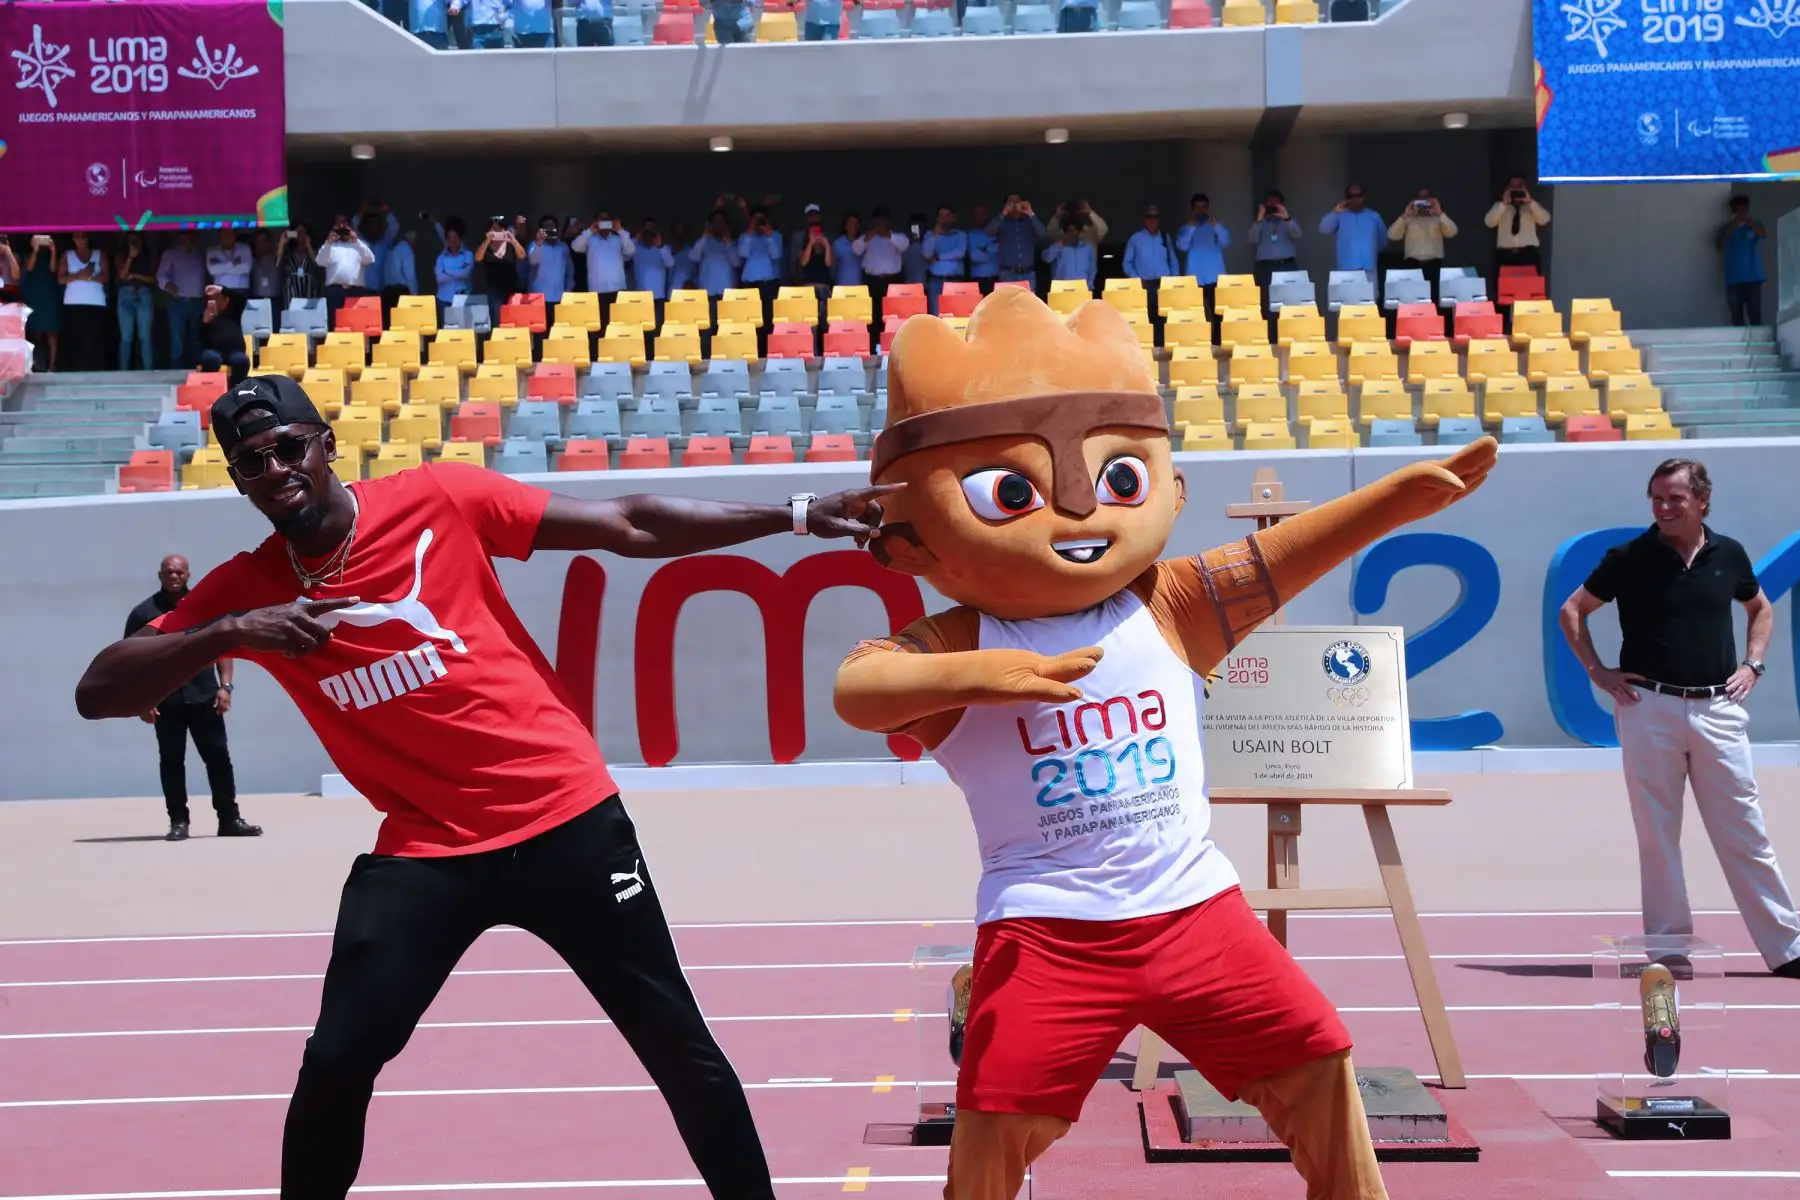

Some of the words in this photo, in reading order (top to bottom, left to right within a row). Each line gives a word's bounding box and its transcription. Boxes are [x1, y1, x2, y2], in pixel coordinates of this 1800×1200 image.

[1642, 13, 1725, 43] 2019
[90, 63, 169, 93] 2019
[1567, 63, 1604, 74] JUEGOS
[1607, 60, 1693, 72] PANAMERICANOS
[1695, 60, 1702, 70] Y
[19, 112, 54, 122] JUEGOS
[56, 111, 140, 122] PANAMERICANOS
[141, 111, 147, 120] Y
[149, 109, 256, 120] PARAPANAMERICANOS
[318, 640, 448, 711] PUMA
[1228, 670, 1269, 683] 2019
[1232, 740, 1284, 754] USAIN
[1291, 740, 1332, 754] BOLT
[1031, 736, 1176, 808] 2019
[1038, 808, 1084, 828] JUEGOS
[1089, 787, 1180, 816] PANAMERICANOS
[1041, 831, 1051, 843] Y
[1054, 803, 1181, 840] PARAPANAMERICANOS
[615, 882, 643, 903] PUMA
